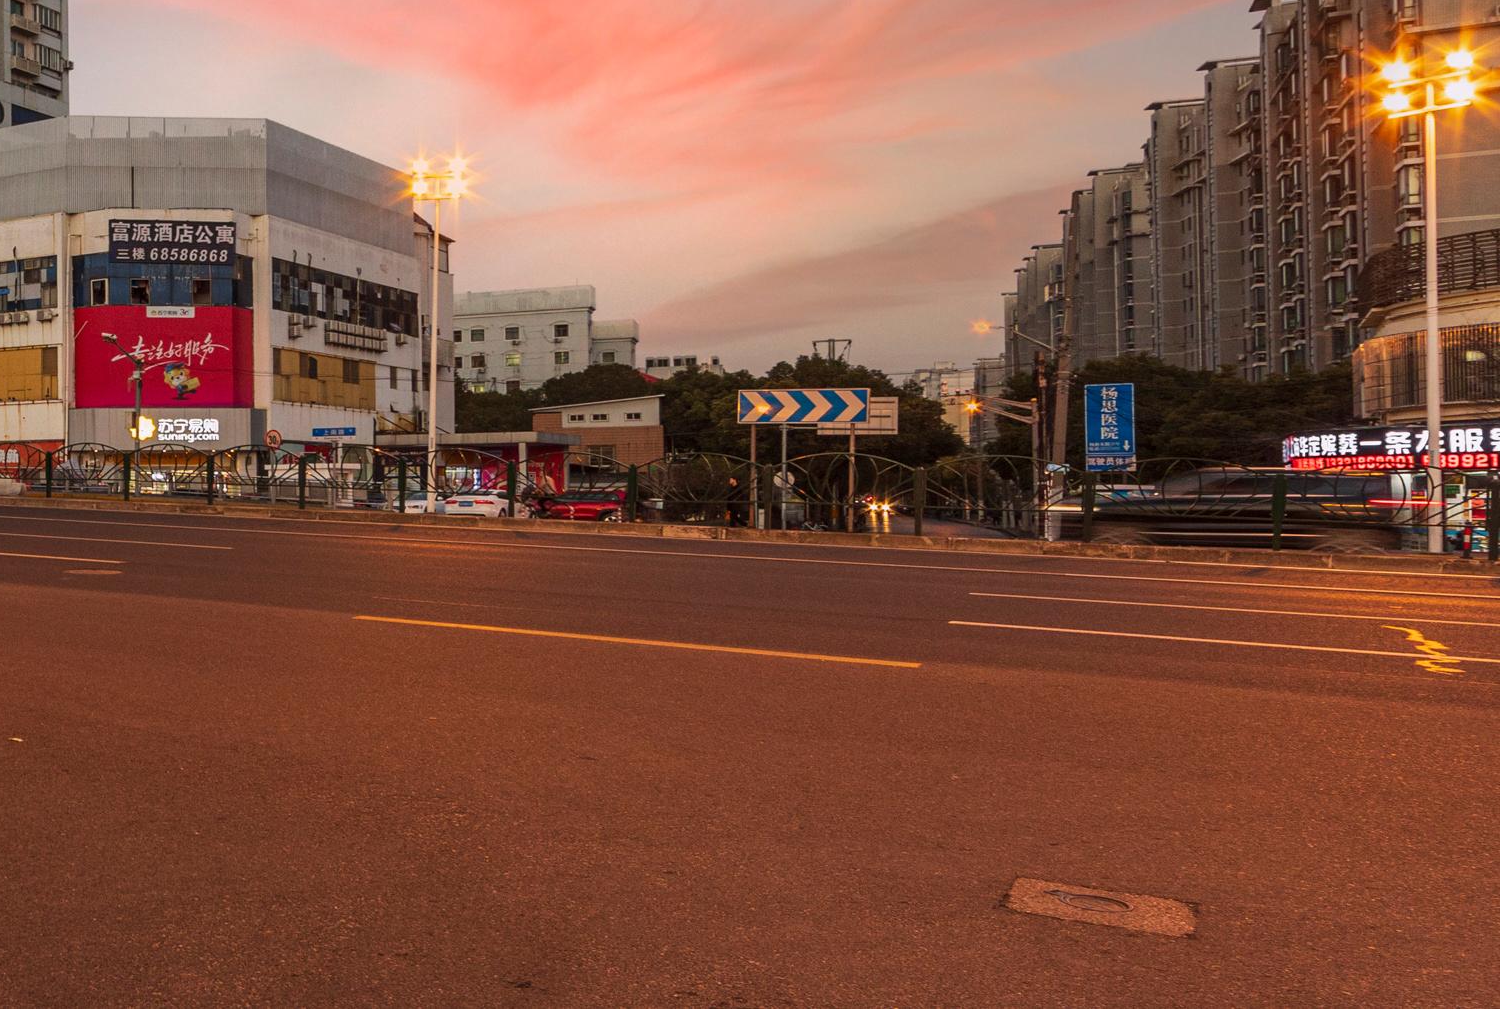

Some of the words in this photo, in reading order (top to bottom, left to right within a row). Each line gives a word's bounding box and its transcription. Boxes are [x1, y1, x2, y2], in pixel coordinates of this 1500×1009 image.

[111, 222, 234, 244] 富源酒店公寓
[116, 248, 145, 260] 三楼
[149, 248, 228, 262] 68586868
[1101, 386, 1118, 440] 杨思医院
[158, 418, 219, 433] 苏宁易购
[158, 433, 219, 442] suning.com
[268, 435, 277, 445] 30
